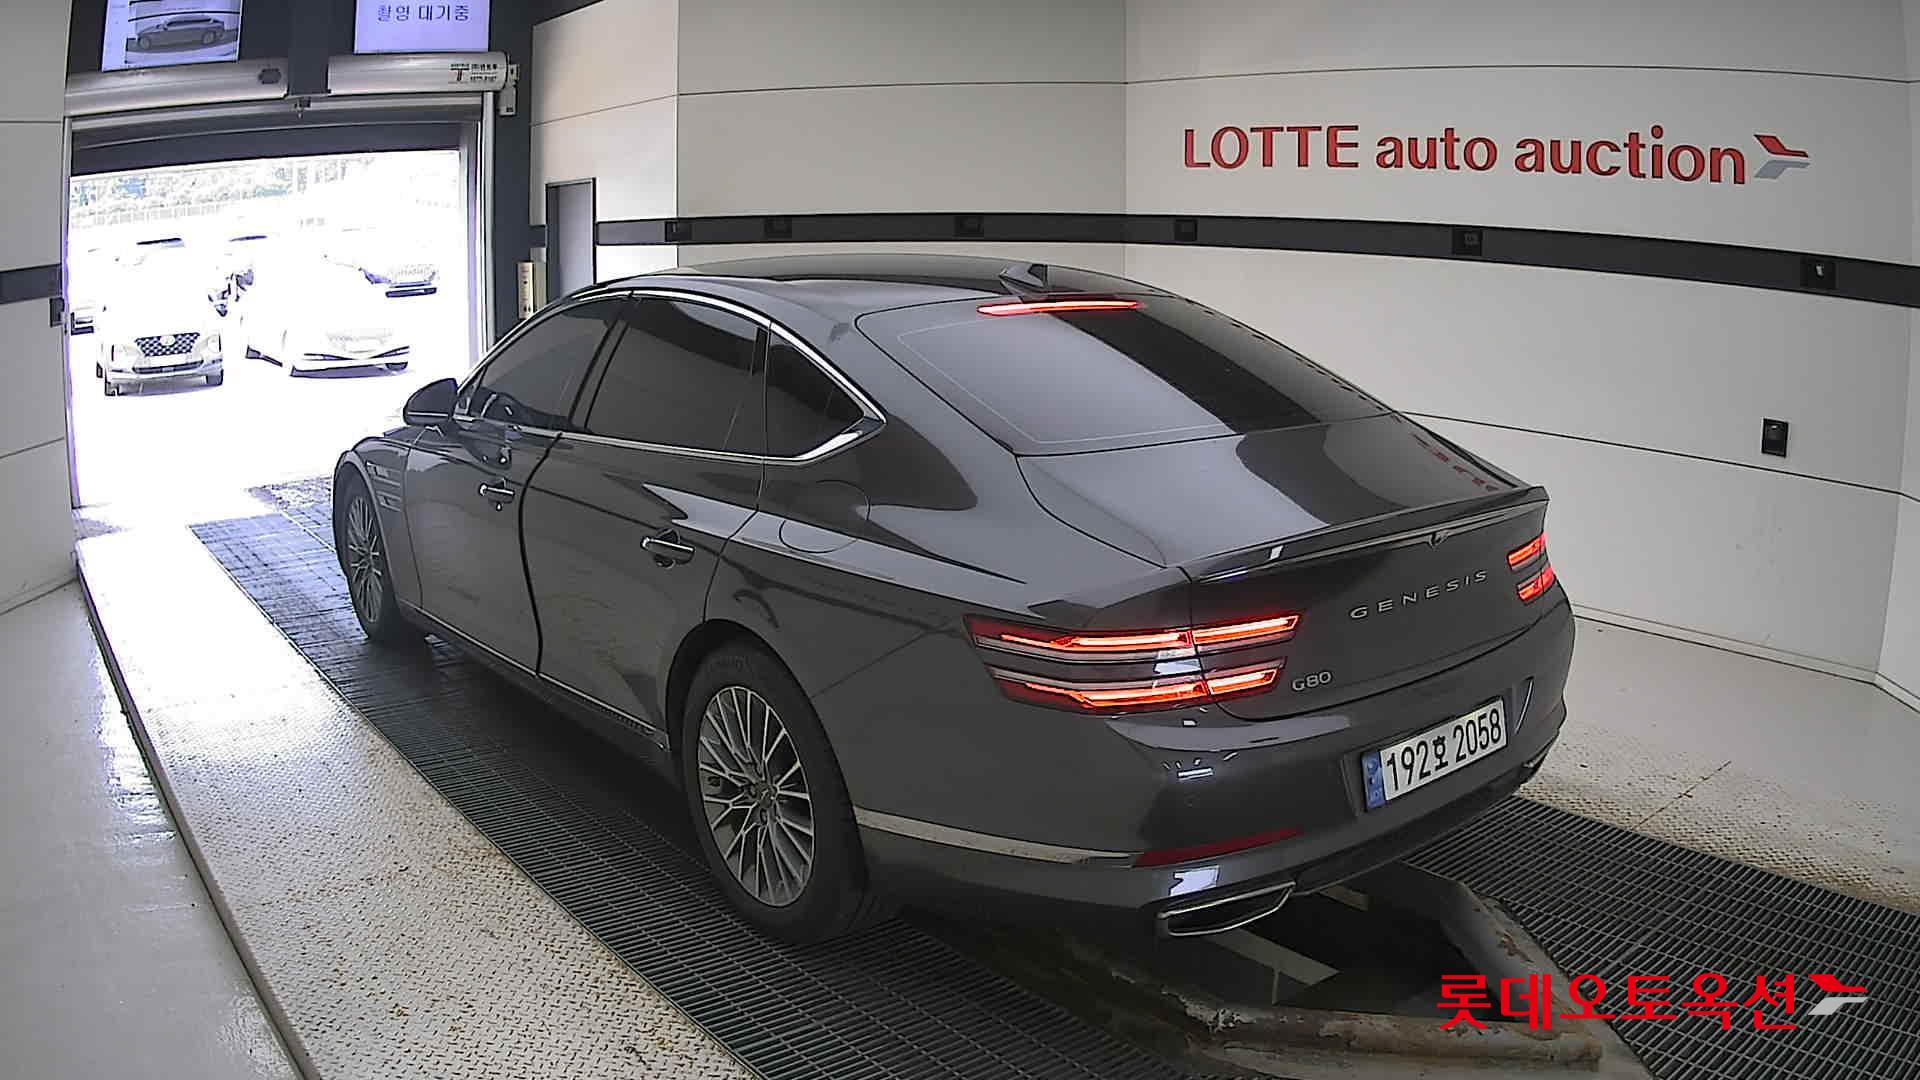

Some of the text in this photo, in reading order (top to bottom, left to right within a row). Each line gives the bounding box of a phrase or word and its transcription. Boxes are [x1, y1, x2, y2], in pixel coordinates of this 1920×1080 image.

[418, 4, 470, 22] 대기중
[1184, 125, 1746, 185] LOTTE auto auction
[1350, 569, 1488, 619] GENESIS
[1291, 671, 1333, 692] G80
[1386, 708, 1502, 791] 192호 2058
